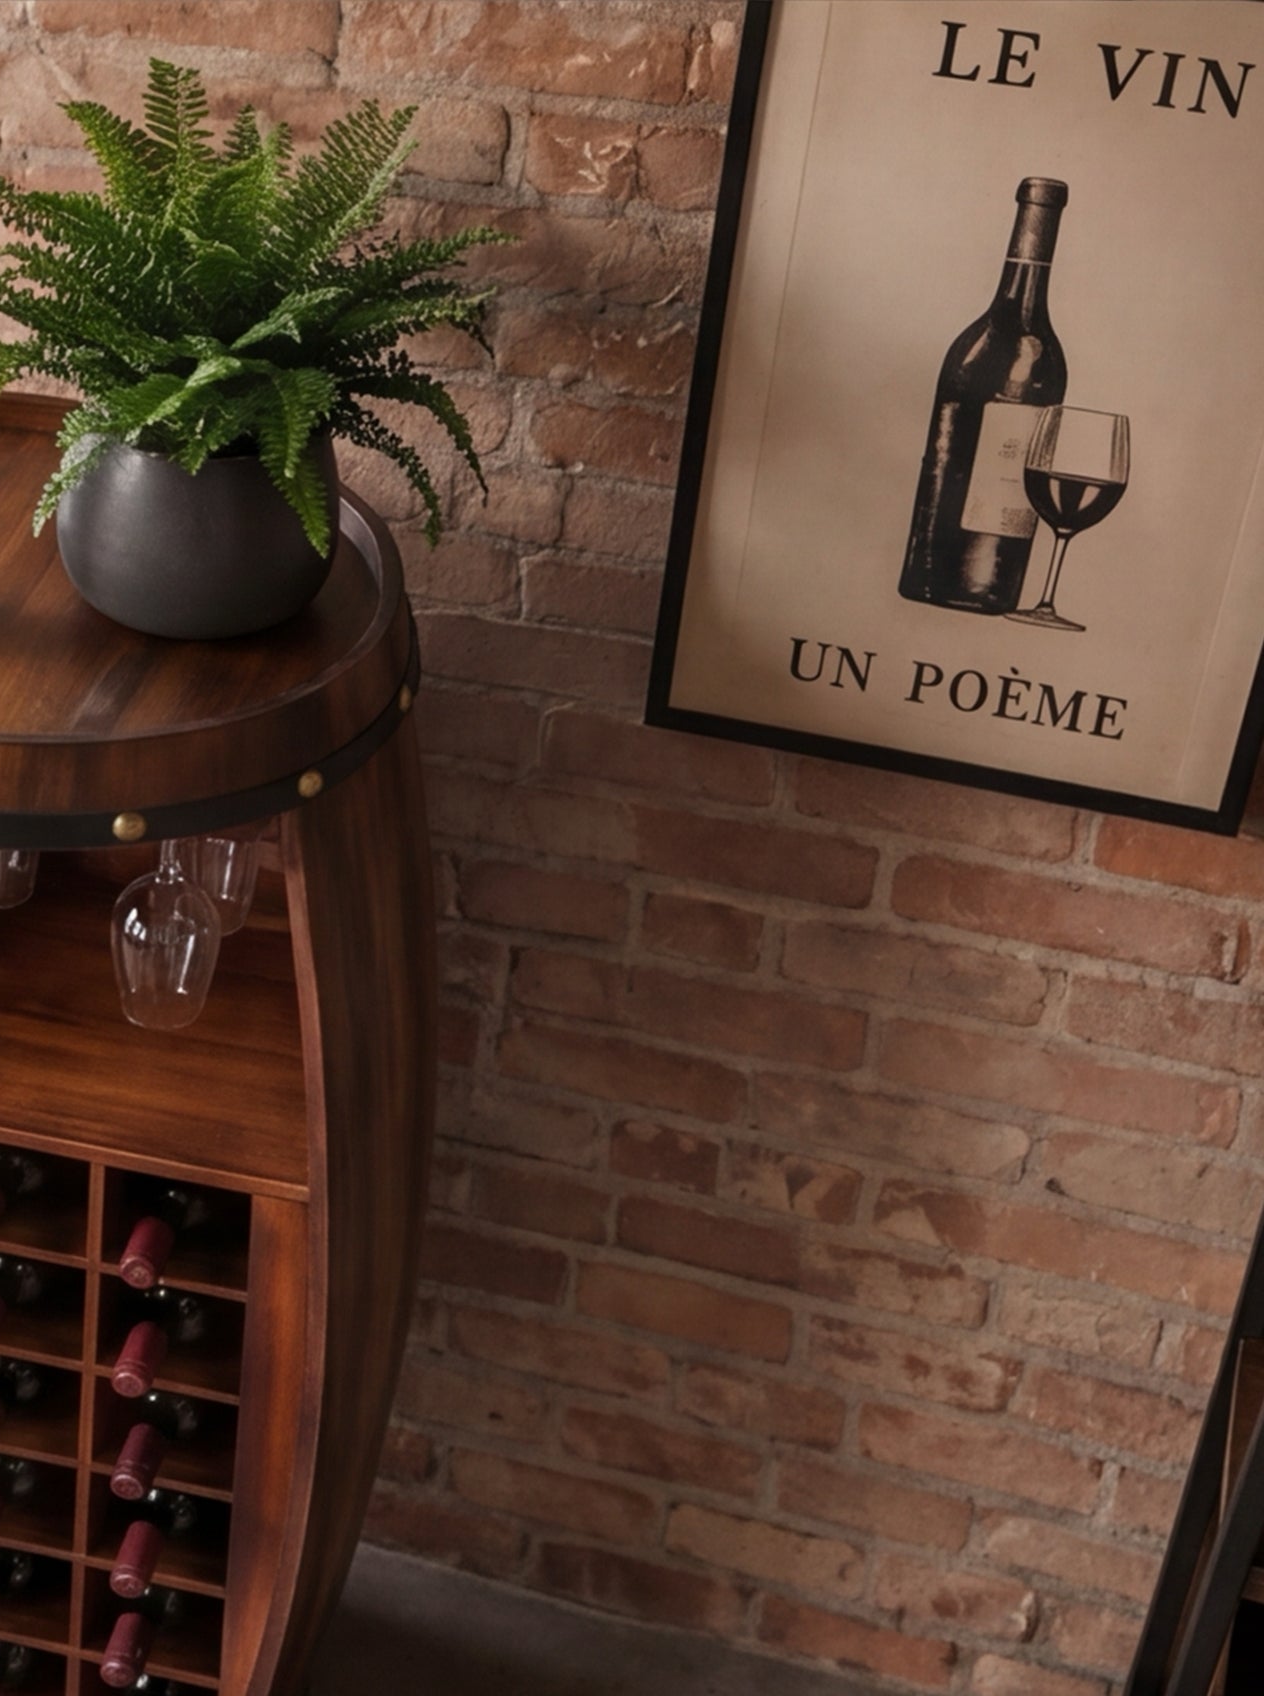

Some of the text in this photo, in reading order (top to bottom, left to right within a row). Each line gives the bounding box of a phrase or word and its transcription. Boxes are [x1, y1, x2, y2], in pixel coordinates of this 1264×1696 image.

[932, 20, 1257, 119] LE VIN
[789, 636, 1129, 741] UN POÈME
